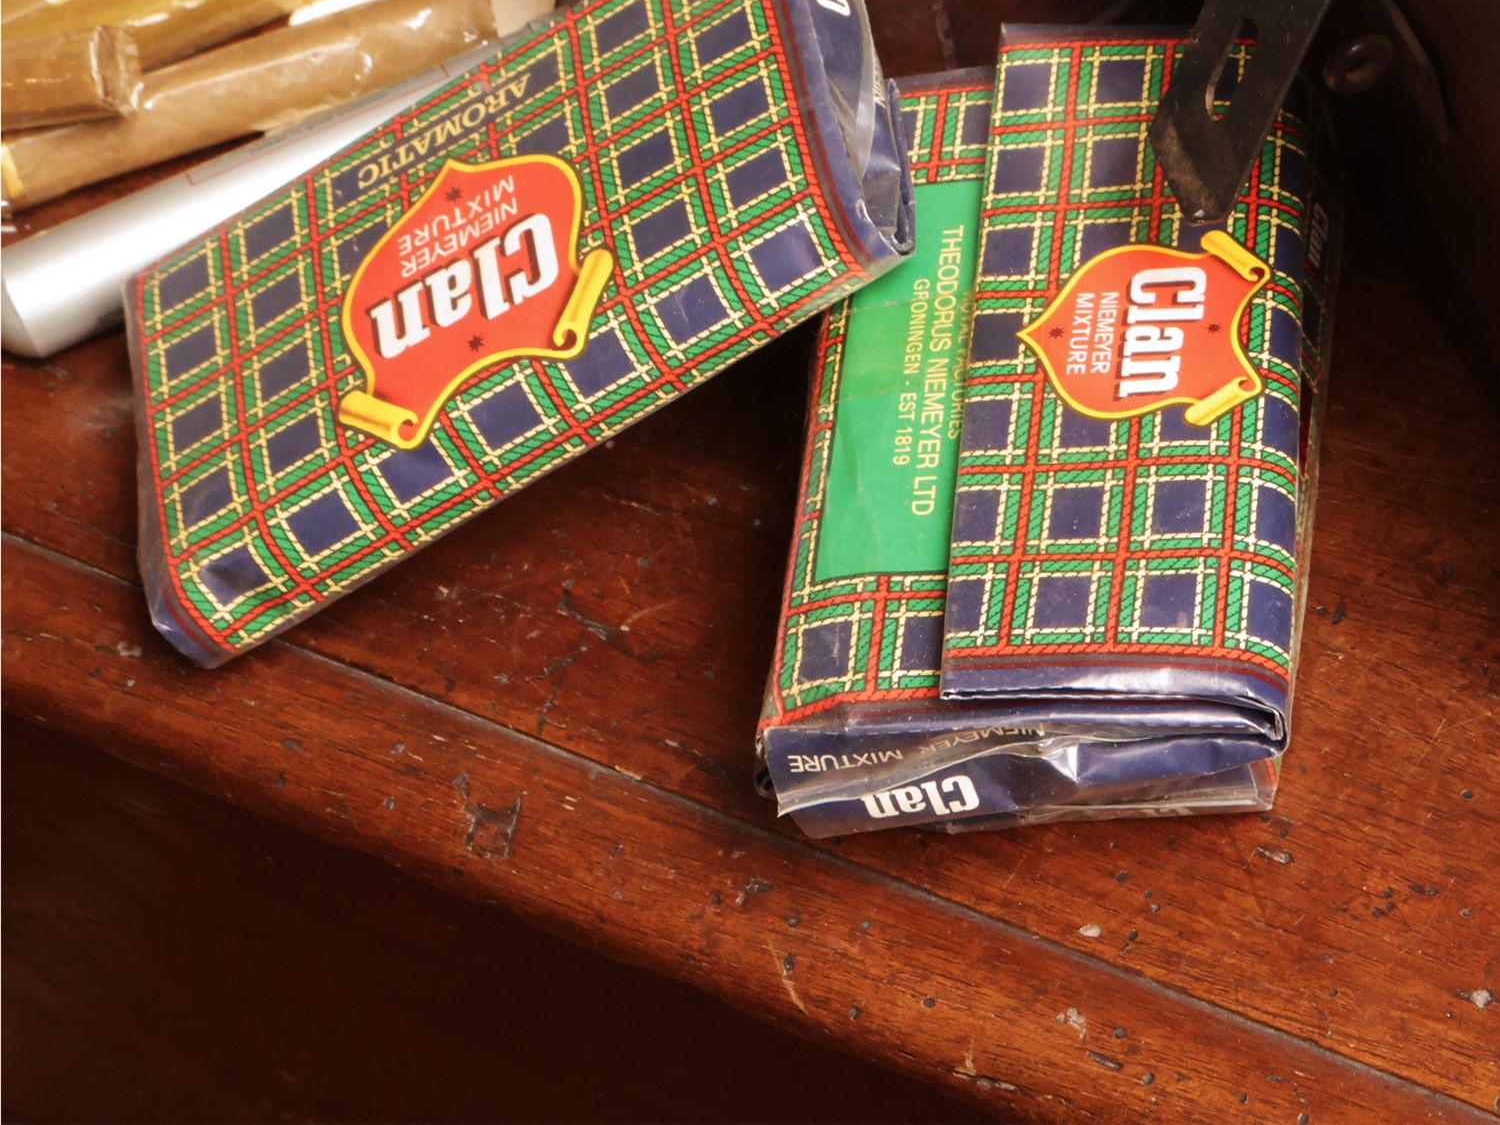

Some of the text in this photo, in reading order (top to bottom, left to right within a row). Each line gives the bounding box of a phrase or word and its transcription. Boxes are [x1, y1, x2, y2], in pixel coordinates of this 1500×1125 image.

[358, 73, 530, 190] AROMATIC
[397, 175, 514, 257] MIXTURE
[401, 197, 518, 278] NIEMEYER
[366, 213, 559, 359] Clan
[903, 278, 931, 375] GRONINGEN
[911, 225, 965, 516] THEODORUS NIEMEYER LTD
[1066, 292, 1096, 375] MIXTURE
[1089, 291, 1120, 375] NIEMEYER
[1116, 266, 1207, 399] Clan
[893, 427, 914, 466] 1819
[898, 392, 918, 422] EST
[787, 749, 904, 774] MIXTURE
[859, 775, 980, 819] Clan
